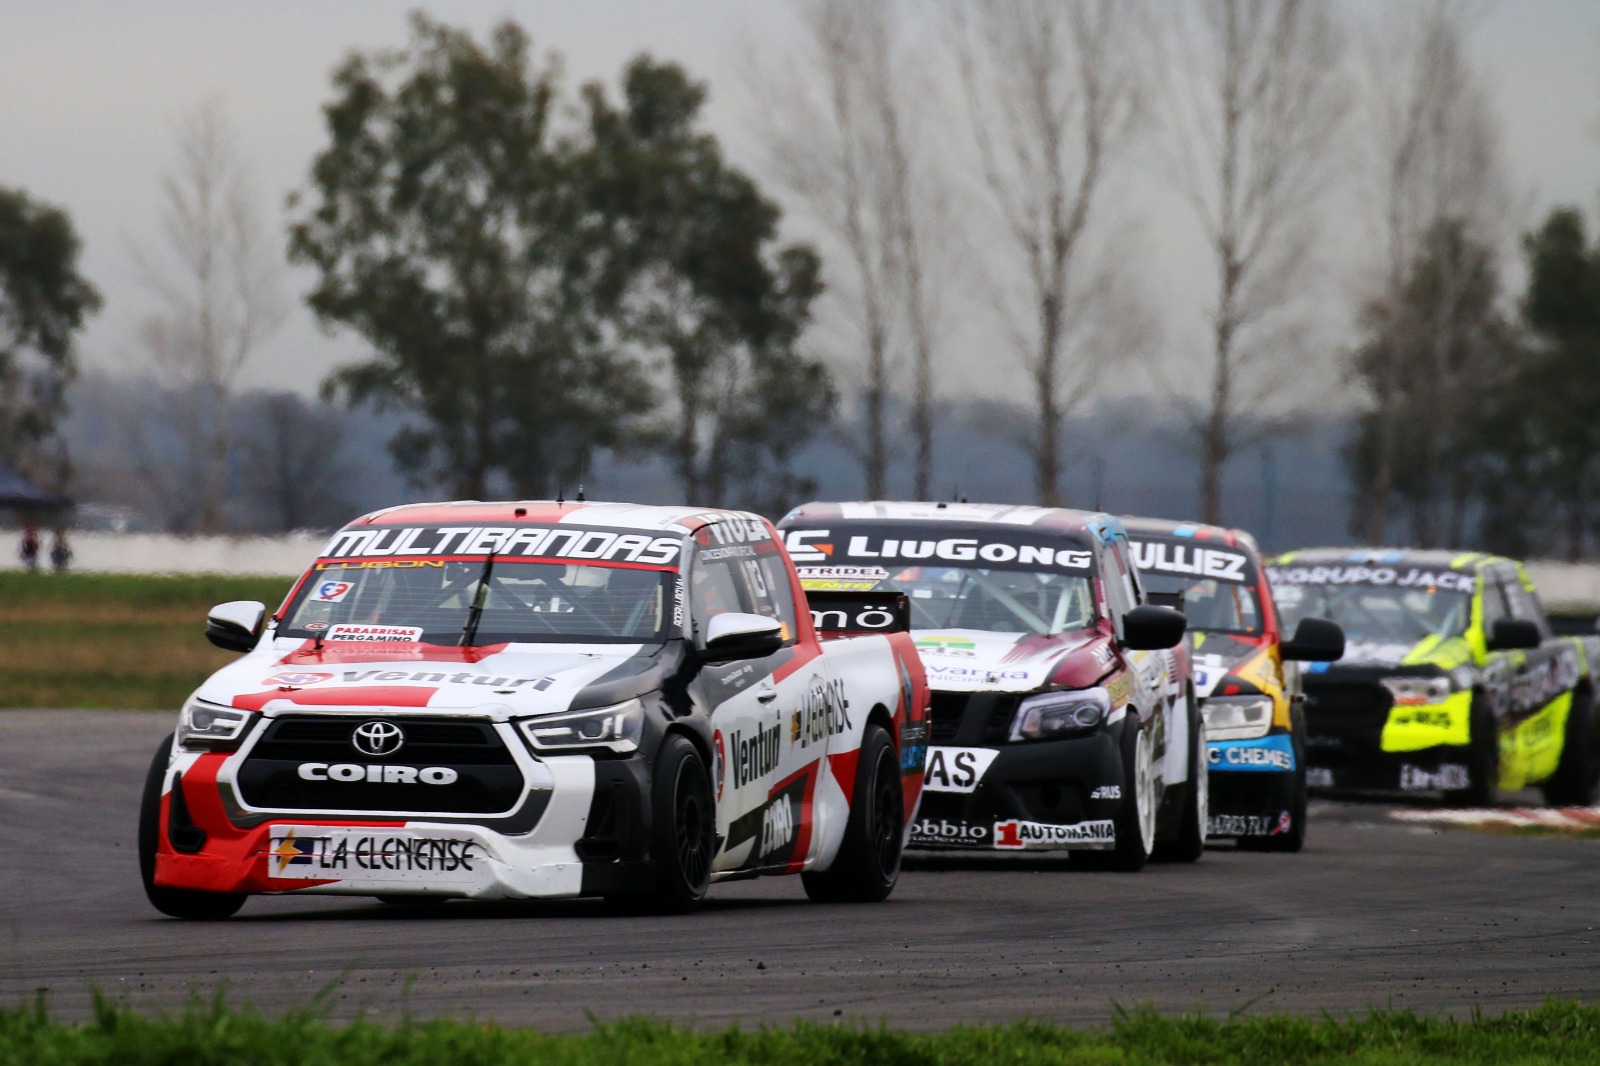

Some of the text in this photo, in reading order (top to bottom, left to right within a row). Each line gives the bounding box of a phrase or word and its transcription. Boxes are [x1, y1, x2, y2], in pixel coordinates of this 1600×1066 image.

[317, 527, 683, 564] MULTIBANDAS
[1286, 566, 1398, 585] GRUPO
[1397, 568, 1476, 593] JACK
[332, 634, 412, 642] PERGAMINO
[335, 627, 416, 636] PARABRISAS
[342, 670, 556, 692] Venturi
[730, 709, 781, 790] Venturi
[1226, 747, 1292, 769] CHEMES
[297, 762, 459, 785] COIRO
[1101, 785, 1121, 799] RUS
[996, 822, 1116, 847] 1 AUTOMANIA
[319, 837, 348, 869] LA
